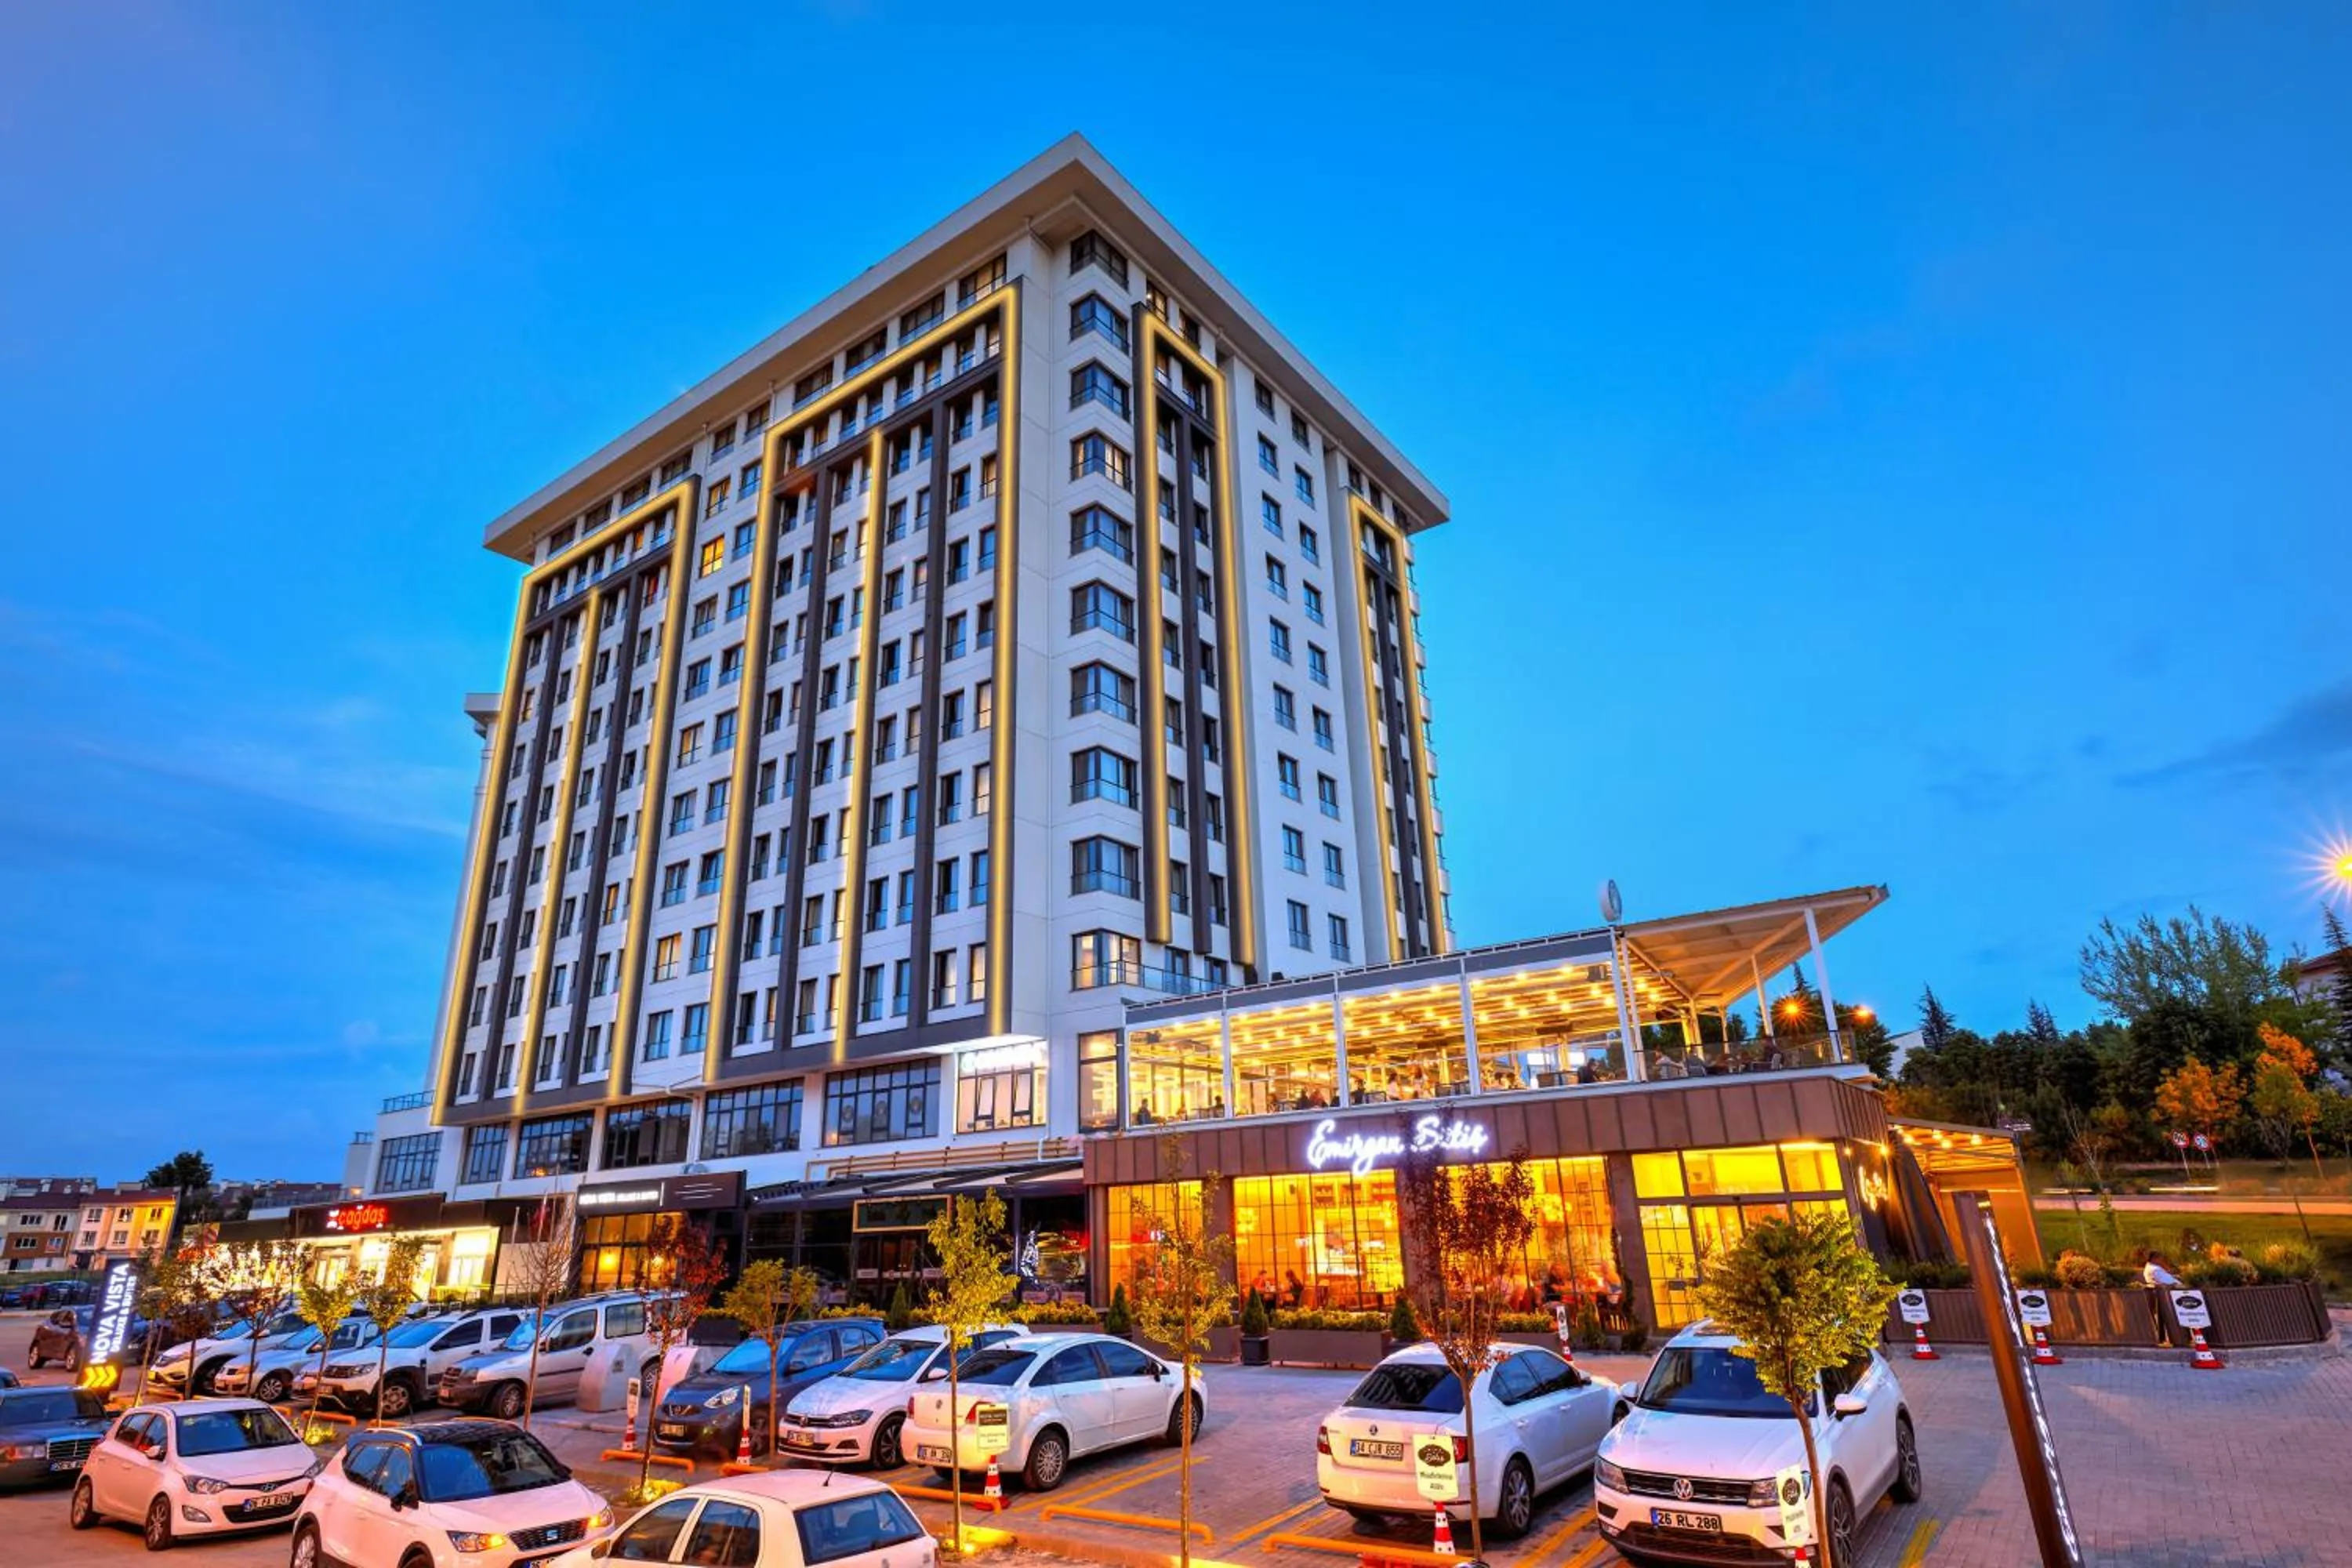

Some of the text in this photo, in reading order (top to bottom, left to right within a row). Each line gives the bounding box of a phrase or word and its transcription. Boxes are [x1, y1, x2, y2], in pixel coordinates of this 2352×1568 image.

[1307, 1119, 1405, 1176] Emirgan
[89, 1263, 129, 1365] NOVA VISTA
[1658, 1512, 1719, 1530] 26 RL 288
